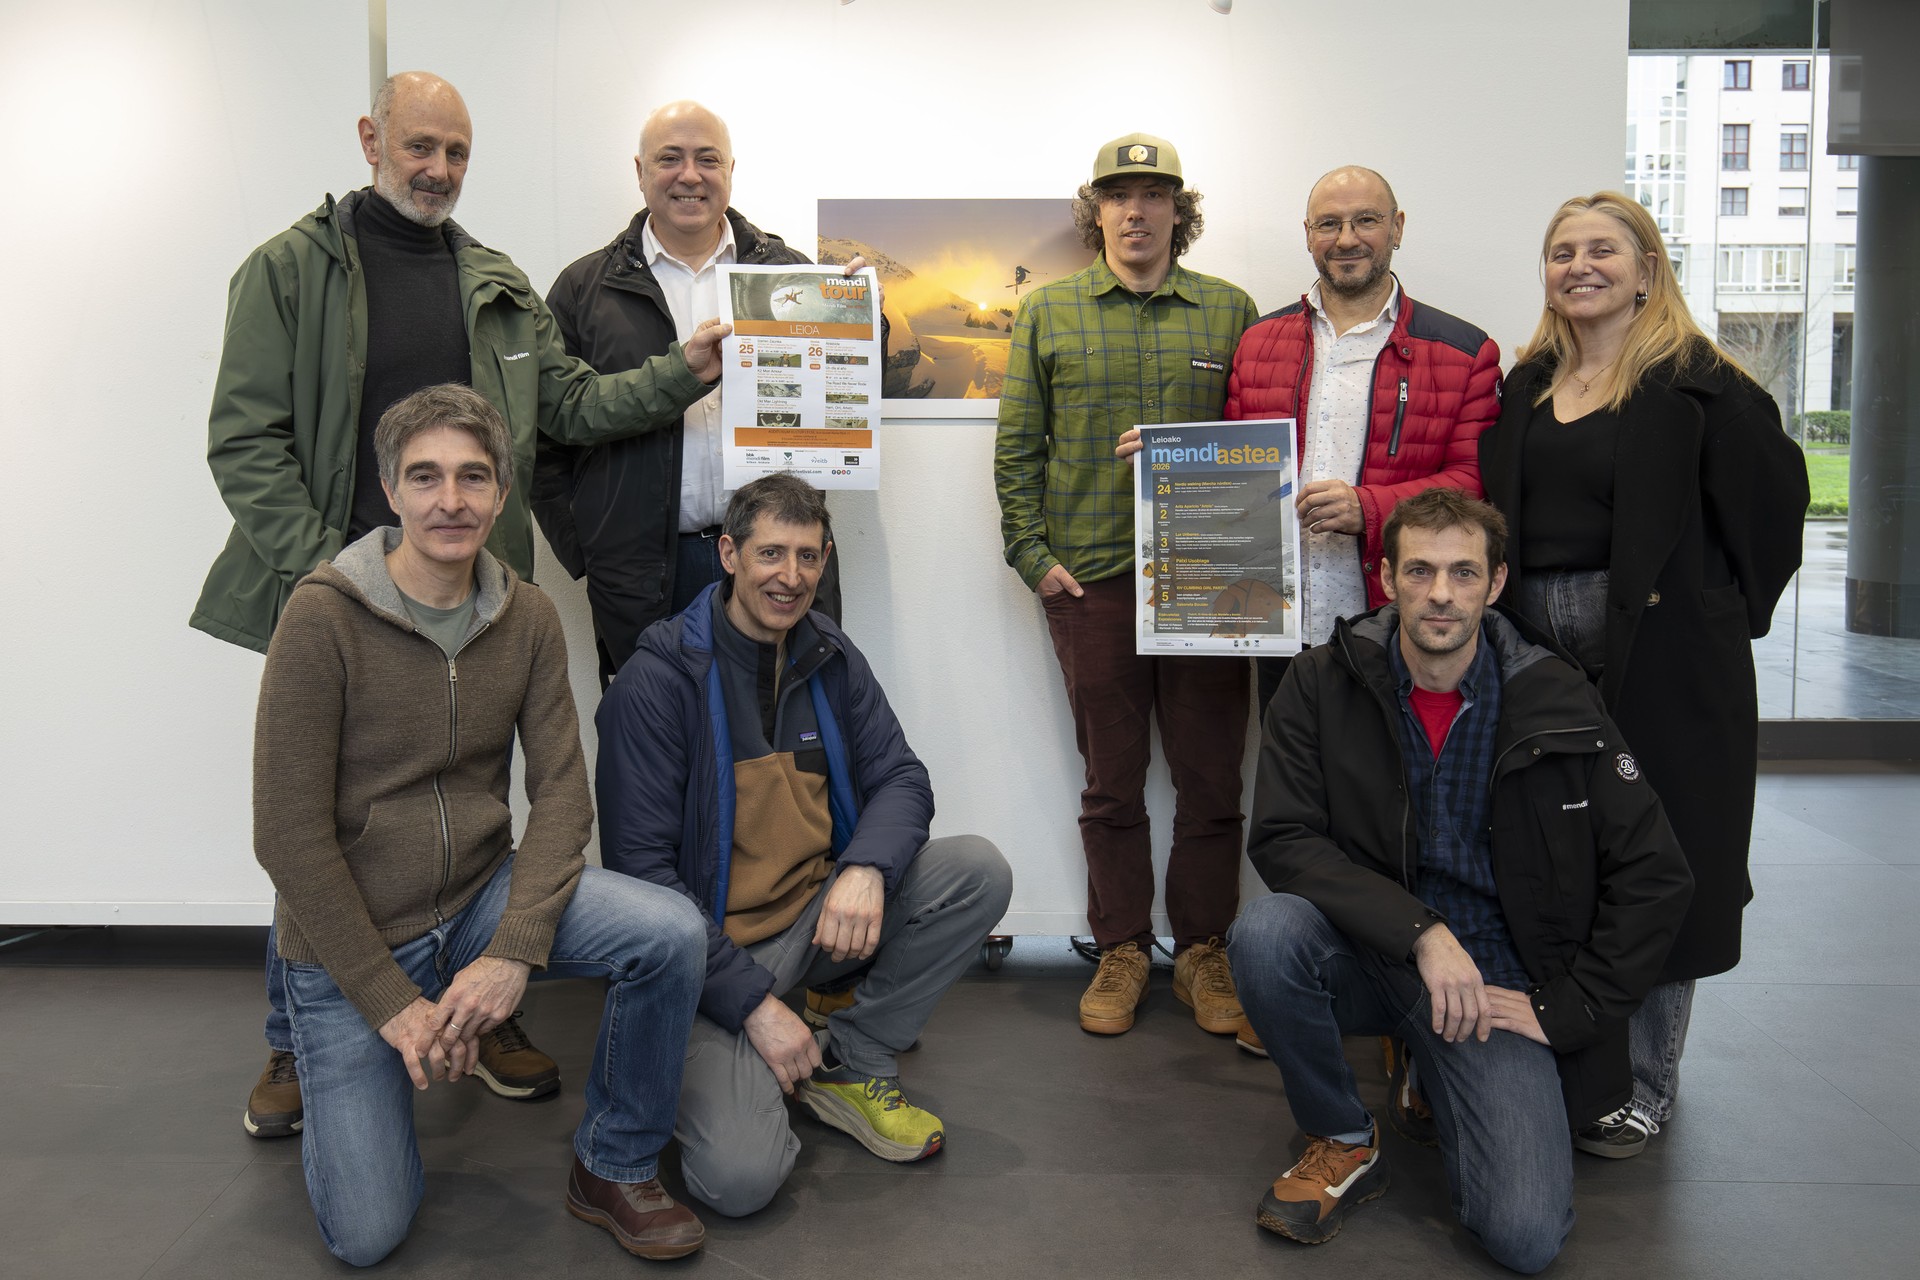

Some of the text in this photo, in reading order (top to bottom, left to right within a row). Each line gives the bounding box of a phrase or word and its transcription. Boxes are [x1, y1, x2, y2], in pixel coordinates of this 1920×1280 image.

[827, 277, 866, 287] mendi
[820, 283, 867, 300] tour
[790, 325, 820, 335] LEIOA
[739, 344, 754, 354] 25
[808, 346, 823, 357] 26
[1151, 442, 1280, 465] mendiastea
[1157, 484, 1171, 495] 24
[1160, 509, 1168, 519] 2
[1160, 537, 1168, 548] 3
[1161, 563, 1169, 573] 4
[1161, 591, 1169, 601] 5
